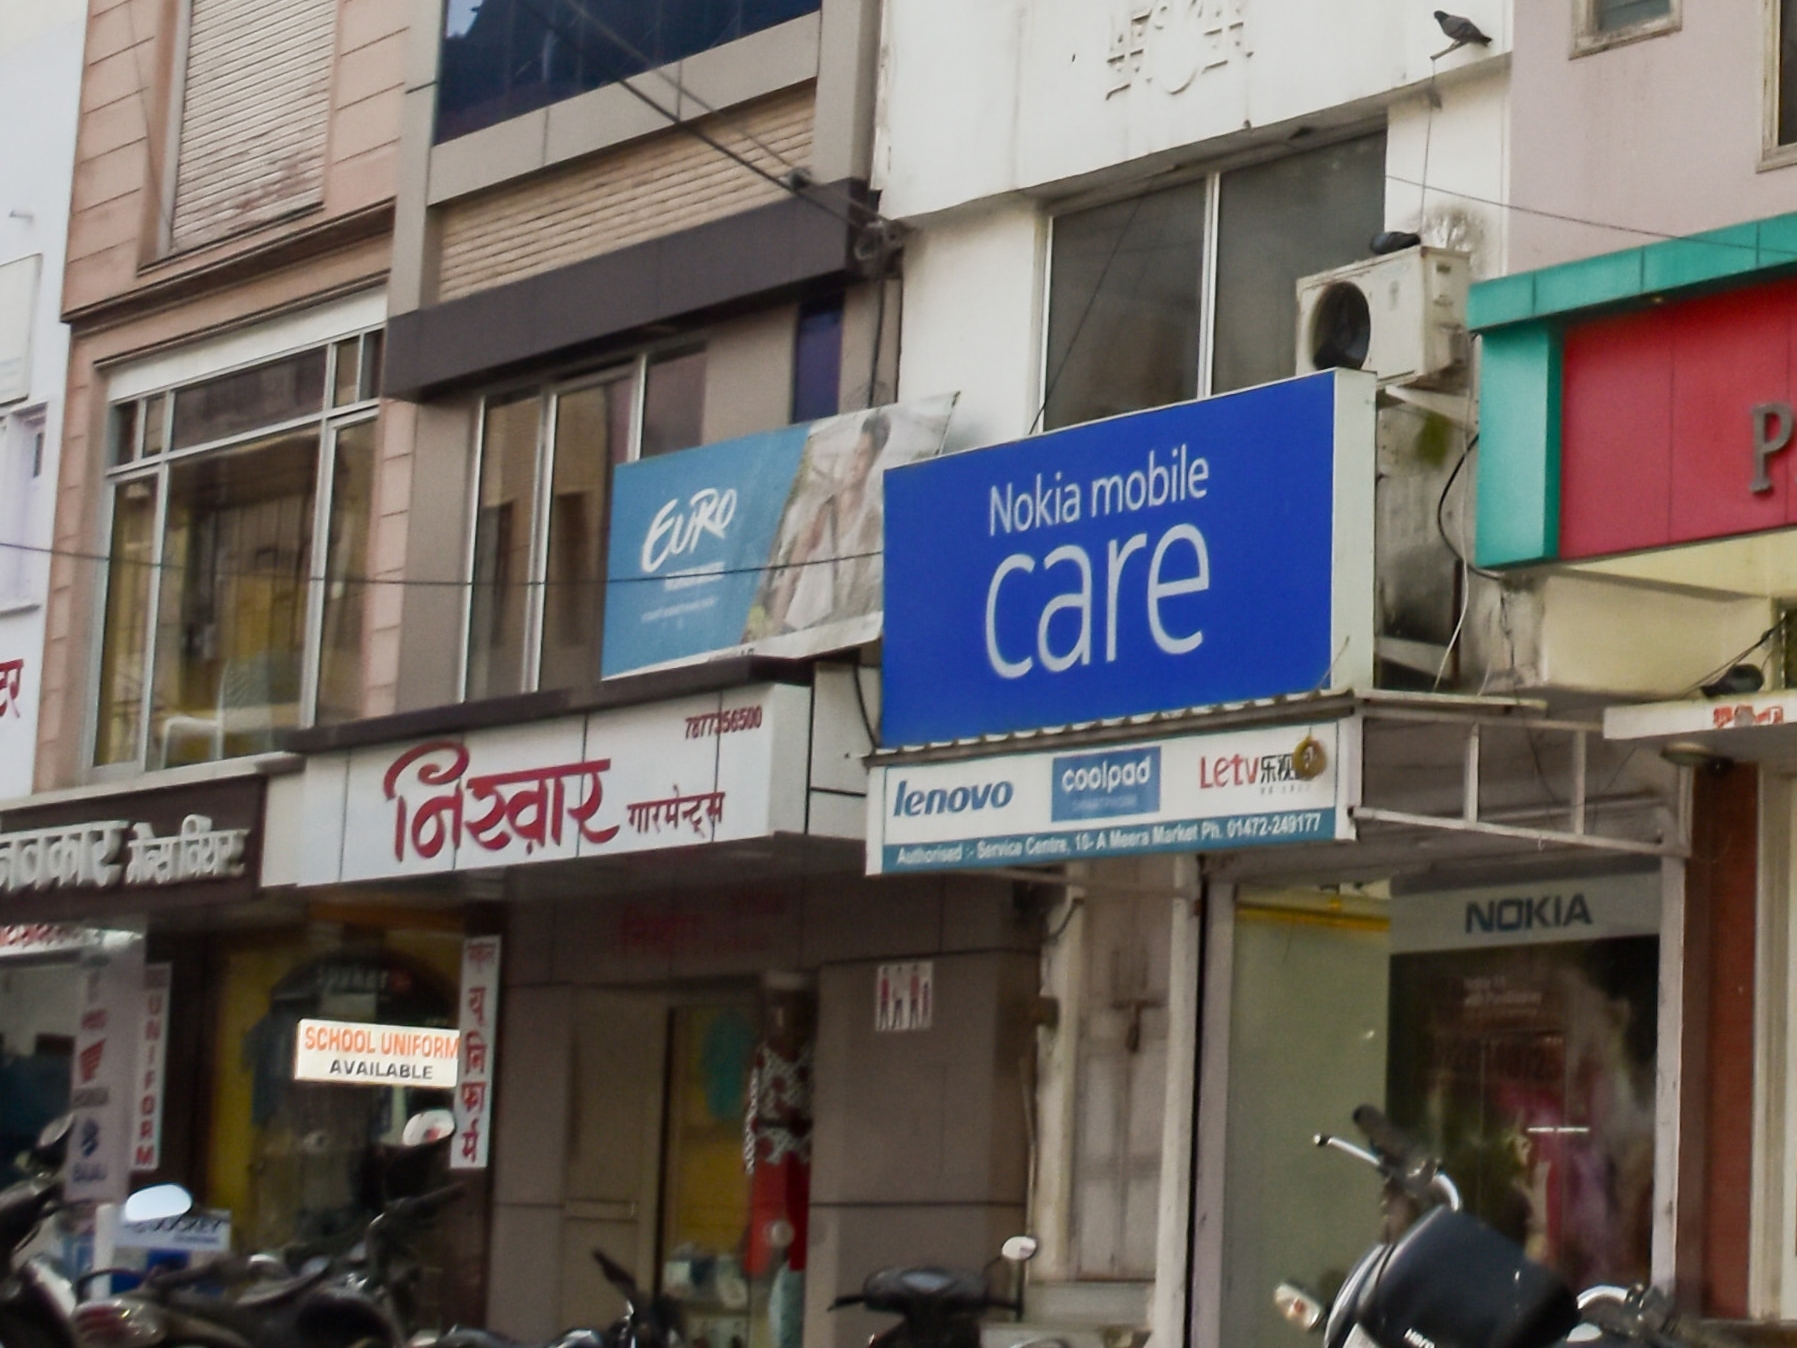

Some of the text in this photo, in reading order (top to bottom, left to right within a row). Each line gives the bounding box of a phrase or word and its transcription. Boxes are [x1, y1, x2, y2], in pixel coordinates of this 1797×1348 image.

[988, 443, 1209, 537] Nokia mobile
[985, 521, 1211, 679] care
[1061, 755, 1152, 794] coolpad
[893, 780, 1014, 817] lenovo
[897, 844, 963, 865] Authorised
[977, 839, 1022, 859] Service
[1109, 829, 1149, 849] Meera
[1152, 823, 1198, 845] Market
[1465, 893, 1593, 934] NOKIA
[305, 1026, 460, 1059] SCHOOL UNIFORM
[329, 1059, 434, 1080] AVAILABLE
